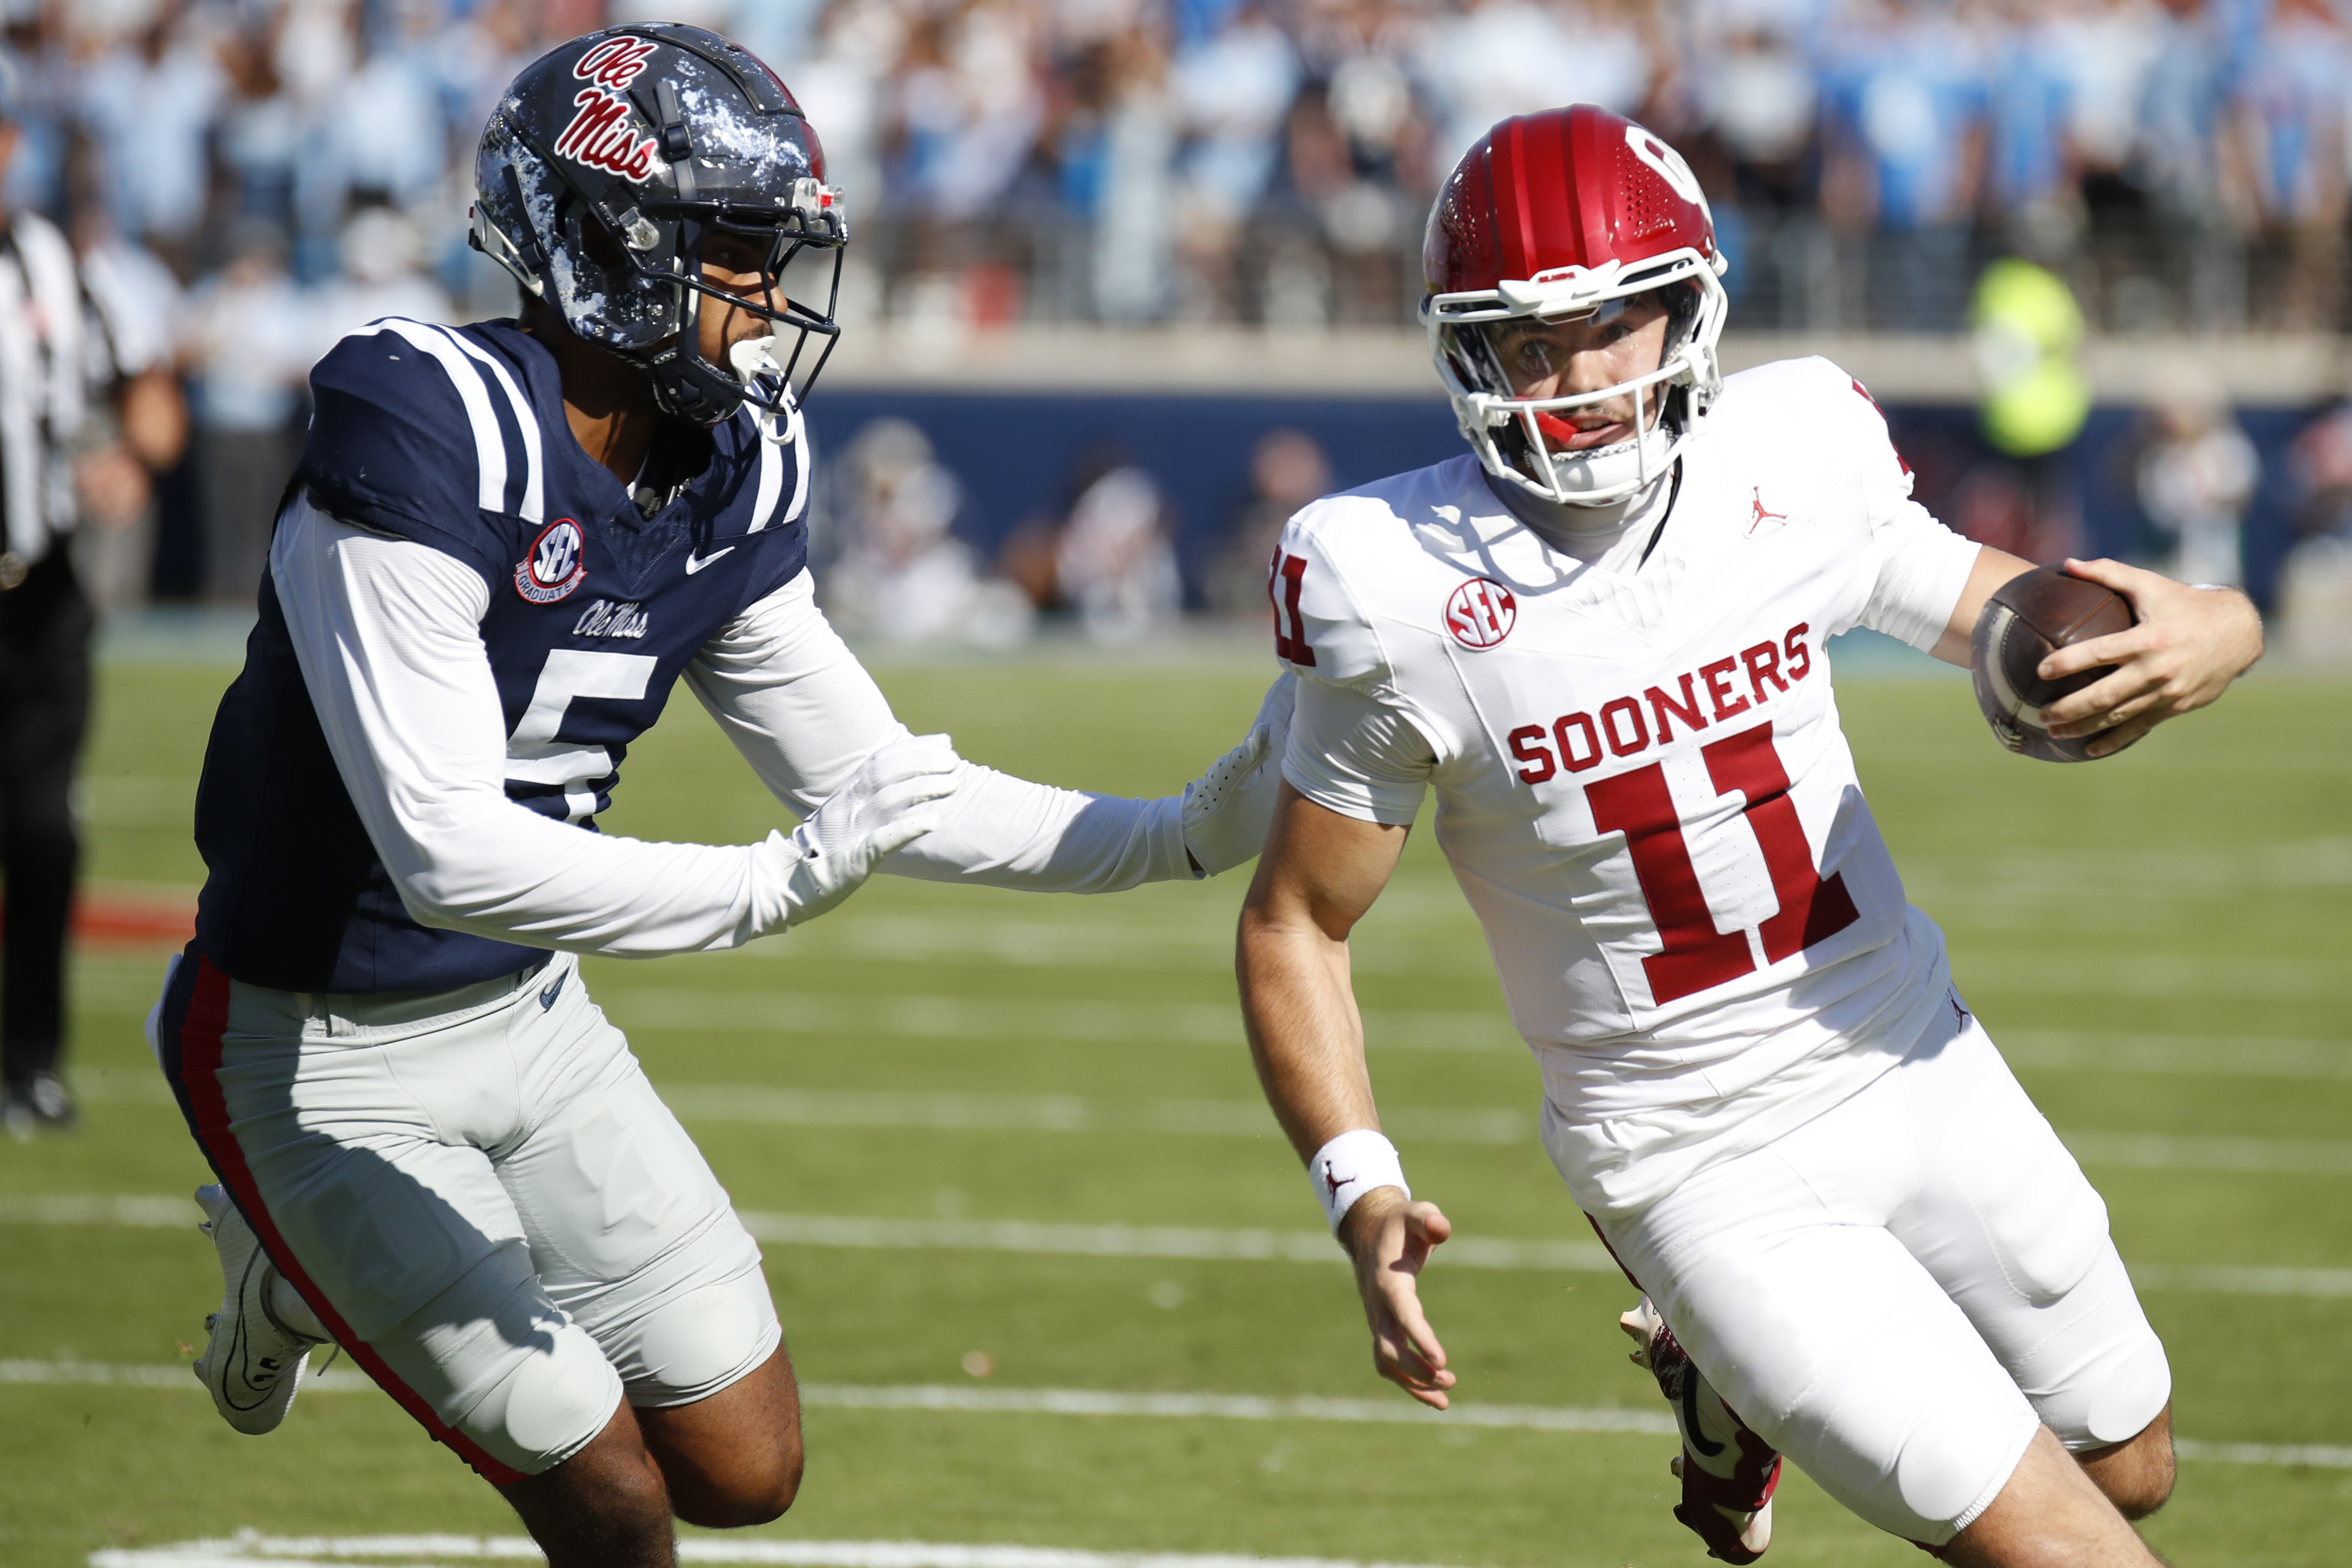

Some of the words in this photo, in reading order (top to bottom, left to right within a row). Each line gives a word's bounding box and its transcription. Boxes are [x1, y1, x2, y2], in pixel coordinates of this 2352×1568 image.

[573, 36, 659, 91] Ole
[554, 87, 661, 183] Miss
[533, 524, 580, 582] SEC
[518, 575, 572, 602] GRADUATE
[573, 599, 615, 637] Ole
[602, 602, 649, 639] Miss
[1448, 580, 1514, 646] SEC
[505, 648, 658, 823] 5
[1508, 622, 1810, 785] SOONERS
[1583, 720, 1861, 1007] 11
